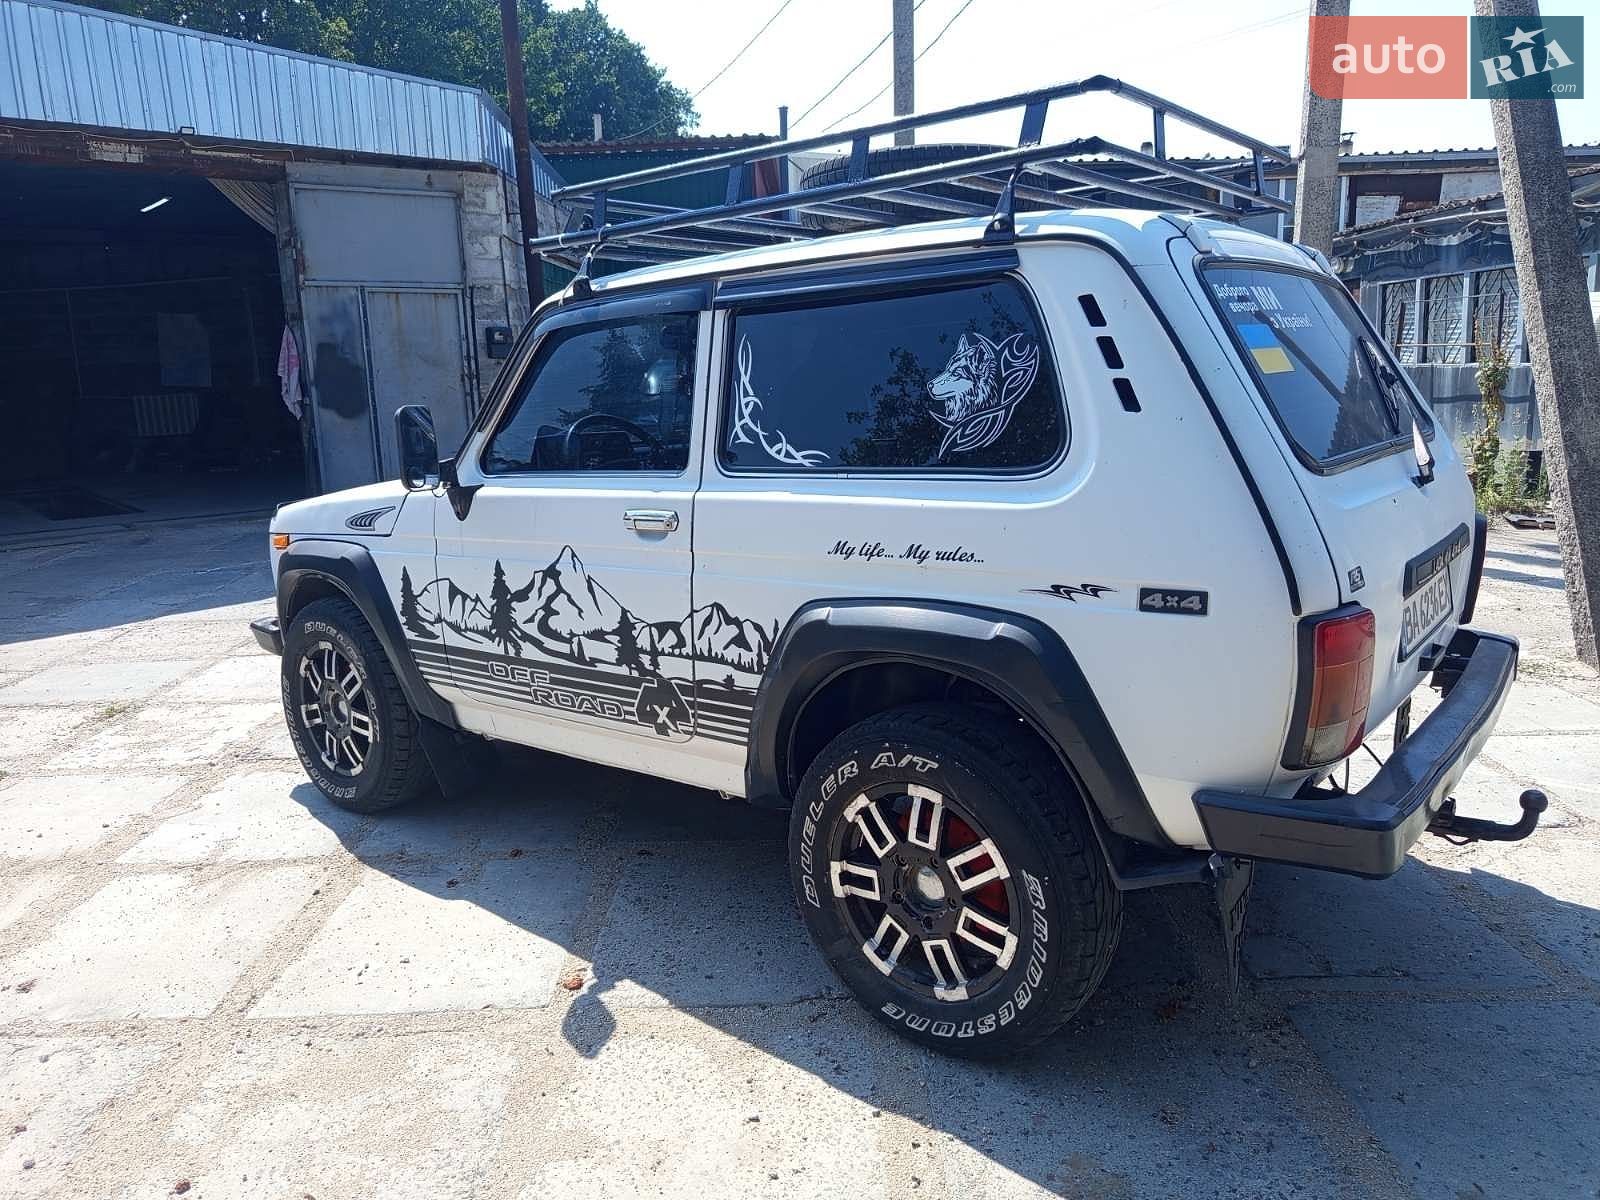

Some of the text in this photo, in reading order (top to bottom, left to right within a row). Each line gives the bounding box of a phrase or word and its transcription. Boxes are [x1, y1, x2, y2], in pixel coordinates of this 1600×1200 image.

[827, 540, 985, 564] My life... My rules...
[1142, 592, 1202, 610] 4x4
[488, 661, 550, 685] OFF
[530, 686, 625, 720] ROAD
[800, 751, 939, 908] DUELER A/T
[881, 868, 1049, 1038] BRIDGESTONE
